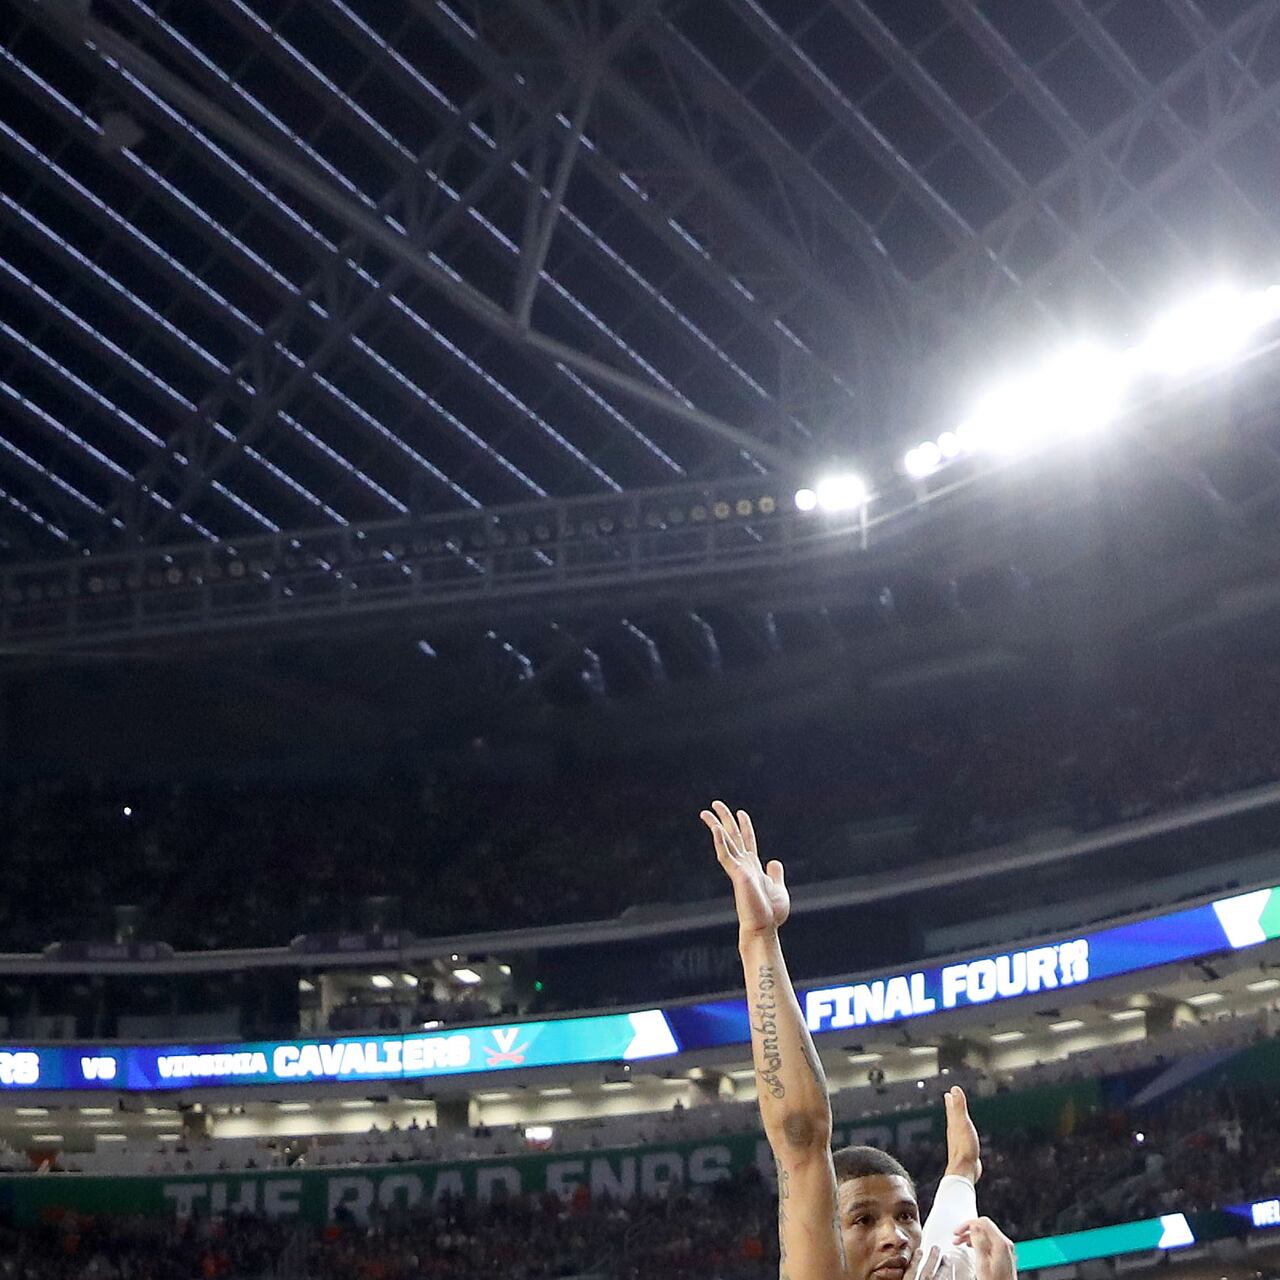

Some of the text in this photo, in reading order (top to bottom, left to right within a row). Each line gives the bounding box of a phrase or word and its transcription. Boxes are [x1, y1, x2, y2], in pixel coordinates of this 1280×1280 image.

[806, 945, 1057, 1034] FINAL FOUR
[80, 1057, 117, 1080] VS
[157, 1052, 268, 1078] VIRGINIA
[273, 1034, 472, 1078] CAVALIERS
[164, 1180, 302, 1213] THE
[328, 1166, 520, 1218] ROAD
